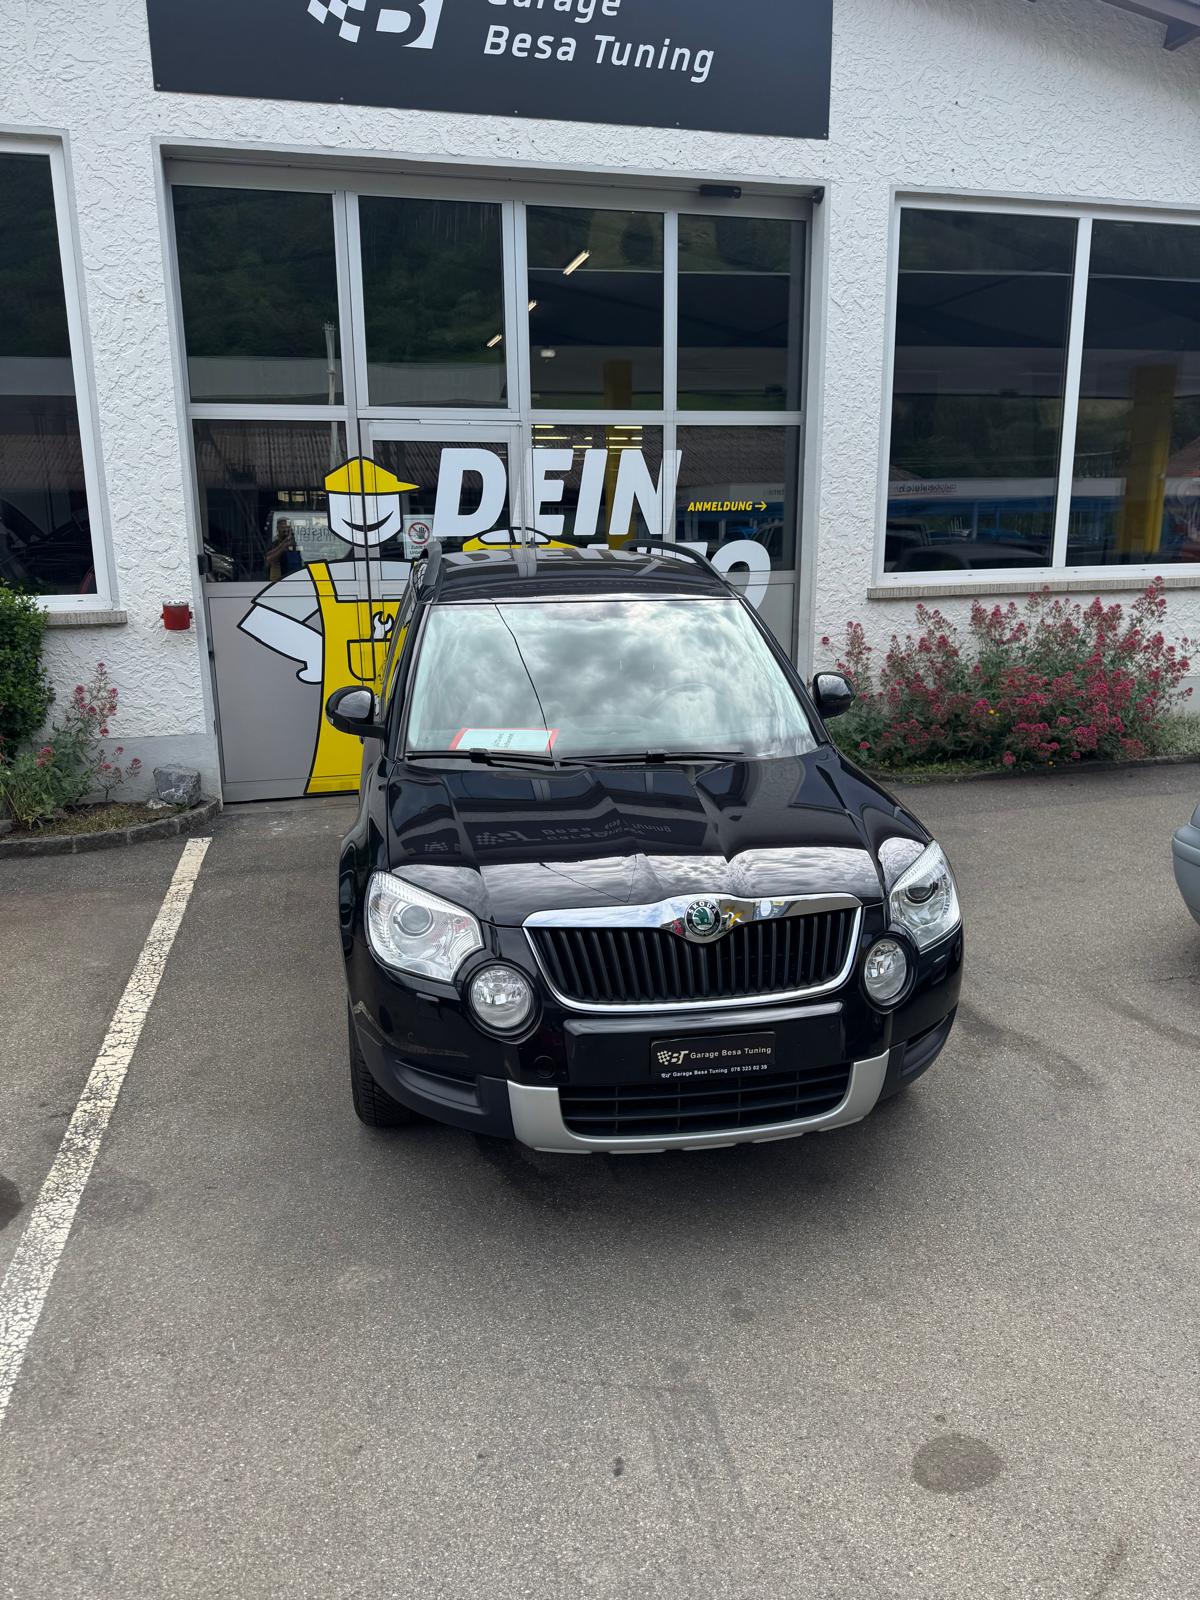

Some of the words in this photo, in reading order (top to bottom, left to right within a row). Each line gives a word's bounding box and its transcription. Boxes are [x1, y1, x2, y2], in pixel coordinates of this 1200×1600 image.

[483, 24, 577, 62] Besa
[594, 34, 715, 83] Tuning
[432, 447, 683, 537] DEIN
[687, 501, 753, 512] ANMELDUNG
[690, 1051, 719, 1059] Garage
[744, 1046, 772, 1054] Tuning
